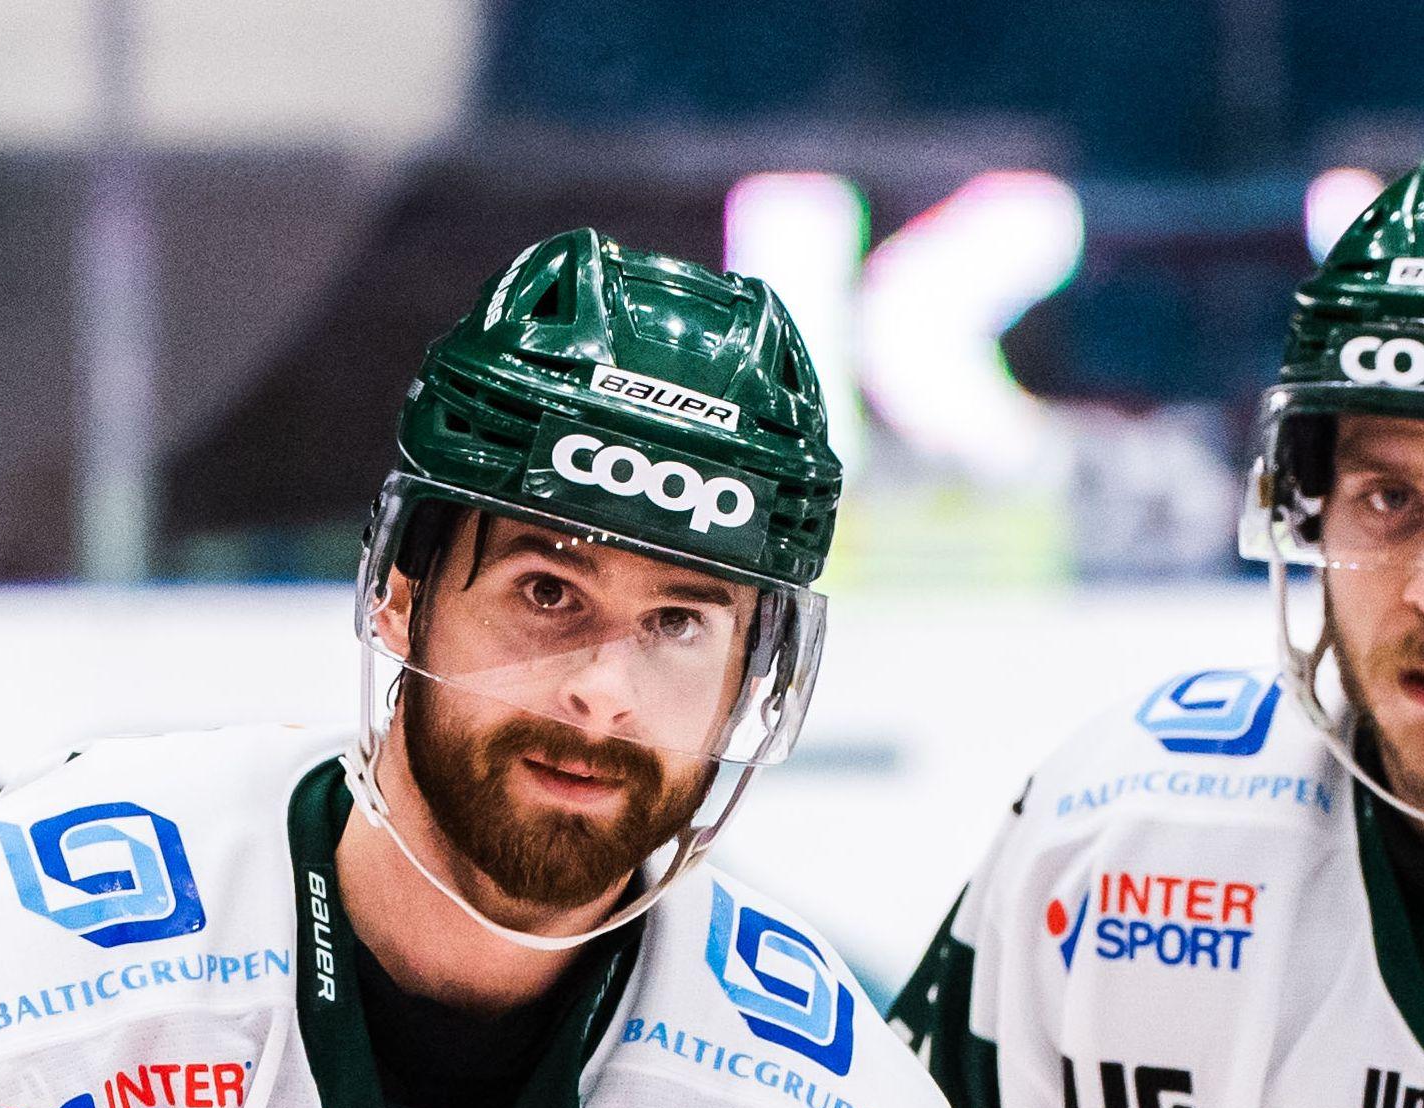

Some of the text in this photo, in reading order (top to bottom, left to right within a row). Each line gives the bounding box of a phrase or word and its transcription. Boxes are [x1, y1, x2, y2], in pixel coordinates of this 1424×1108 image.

[551, 434, 755, 534] coop
[1099, 872, 1258, 924] INTER
[1096, 918, 1253, 970] SPORT
